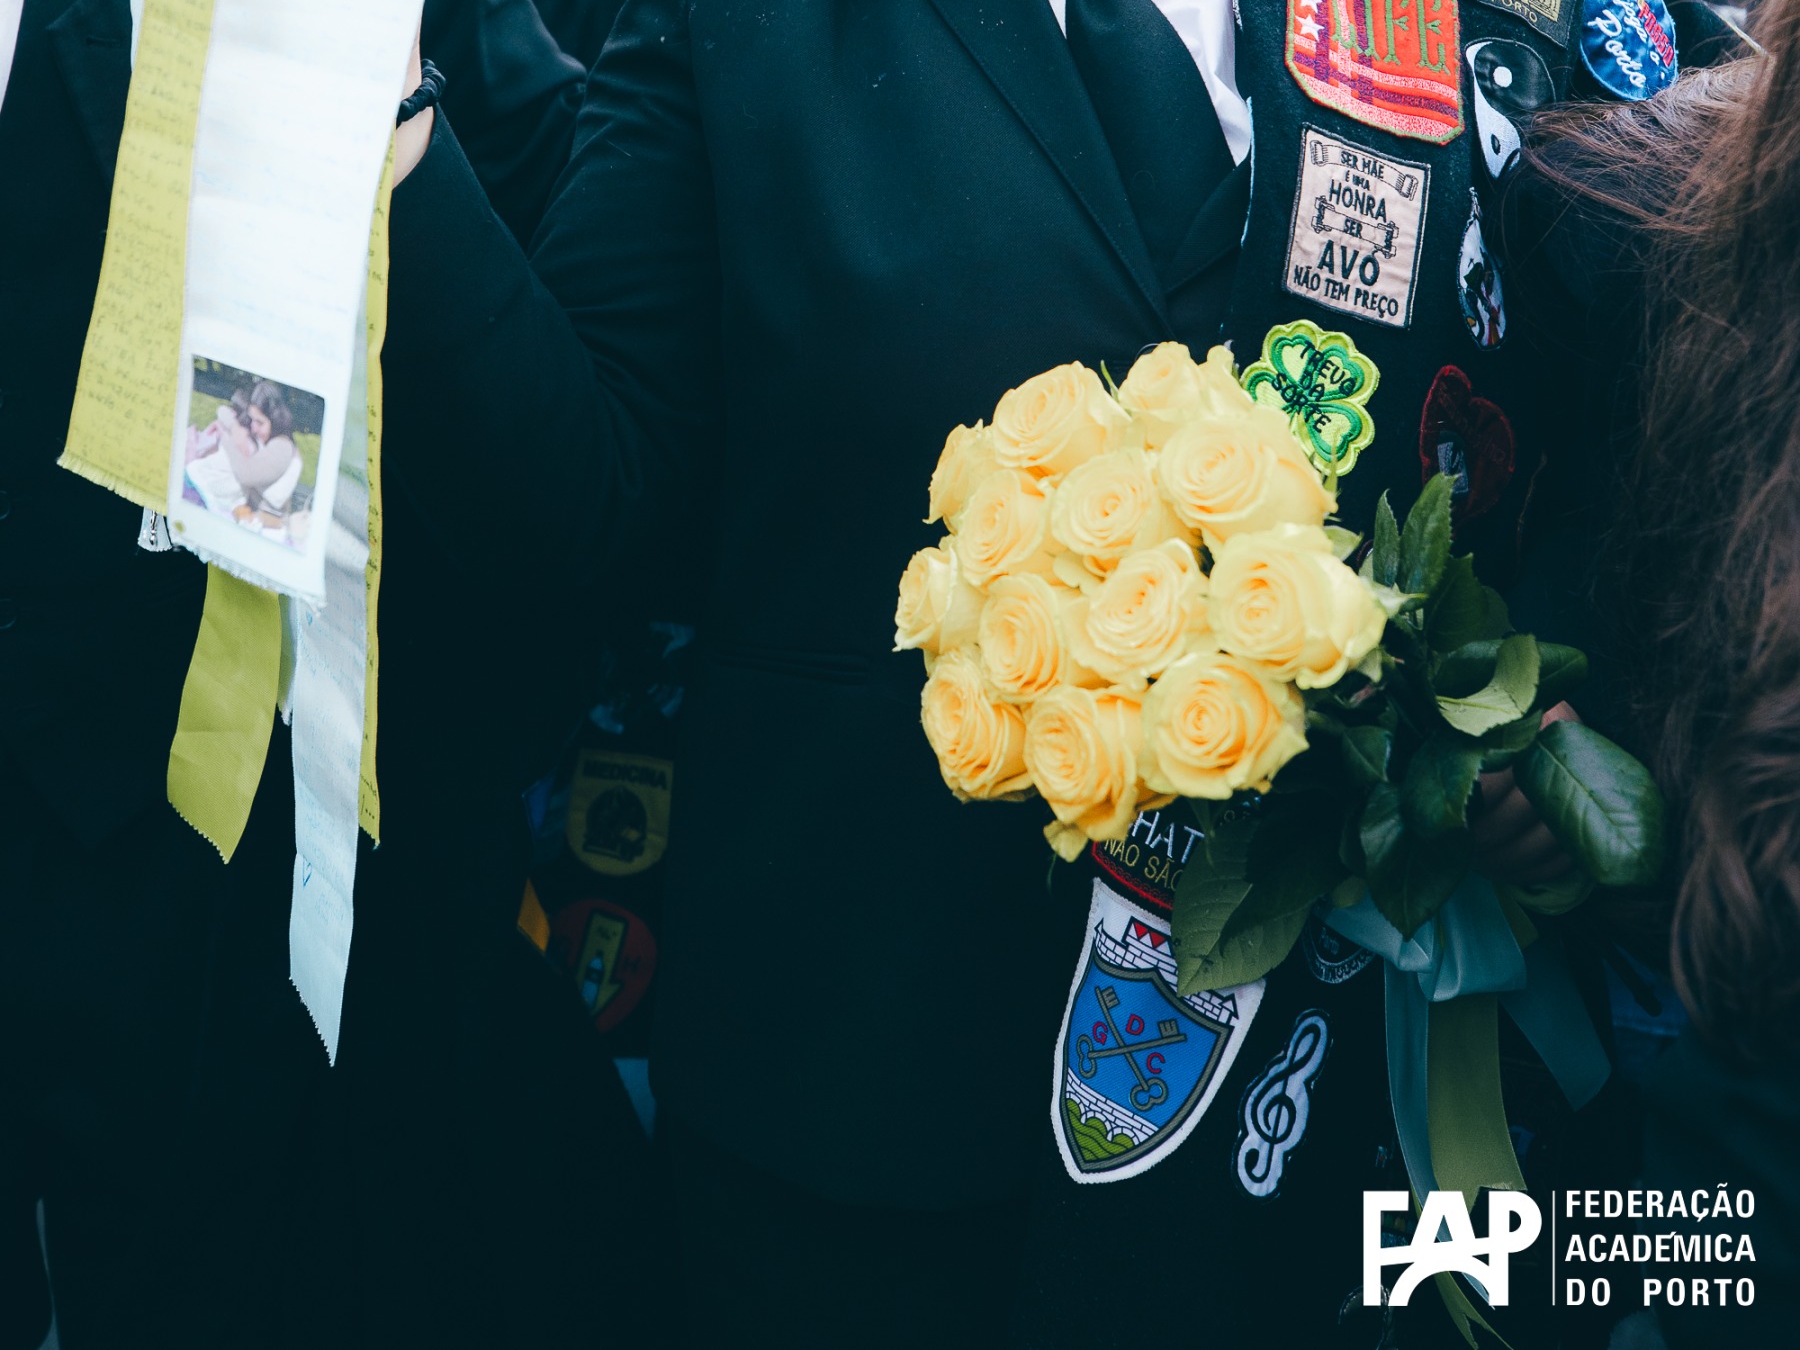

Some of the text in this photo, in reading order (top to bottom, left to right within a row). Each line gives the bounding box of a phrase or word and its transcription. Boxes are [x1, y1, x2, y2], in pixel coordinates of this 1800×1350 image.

[1587, 9, 1646, 88] Porto
[1638, 2, 1674, 68] POSSO
[1340, 151, 1385, 179] SER MÃE
[1352, 175, 1370, 191] UMA
[1329, 179, 1387, 222] HONRA
[1344, 220, 1363, 239] SER
[1317, 239, 1380, 286] AVÓ
[1293, 264, 1398, 318] NÃO TEM PREÇO
[1299, 370, 1325, 402] DA
[1300, 340, 1357, 396] TREVO
[1271, 373, 1332, 433] SORTE
[582, 760, 668, 791] MEDICINA
[1129, 810, 1205, 864] HAT
[1092, 1021, 1108, 1045] G
[1125, 1013, 1145, 1035] D
[1147, 1052, 1165, 1074] C
